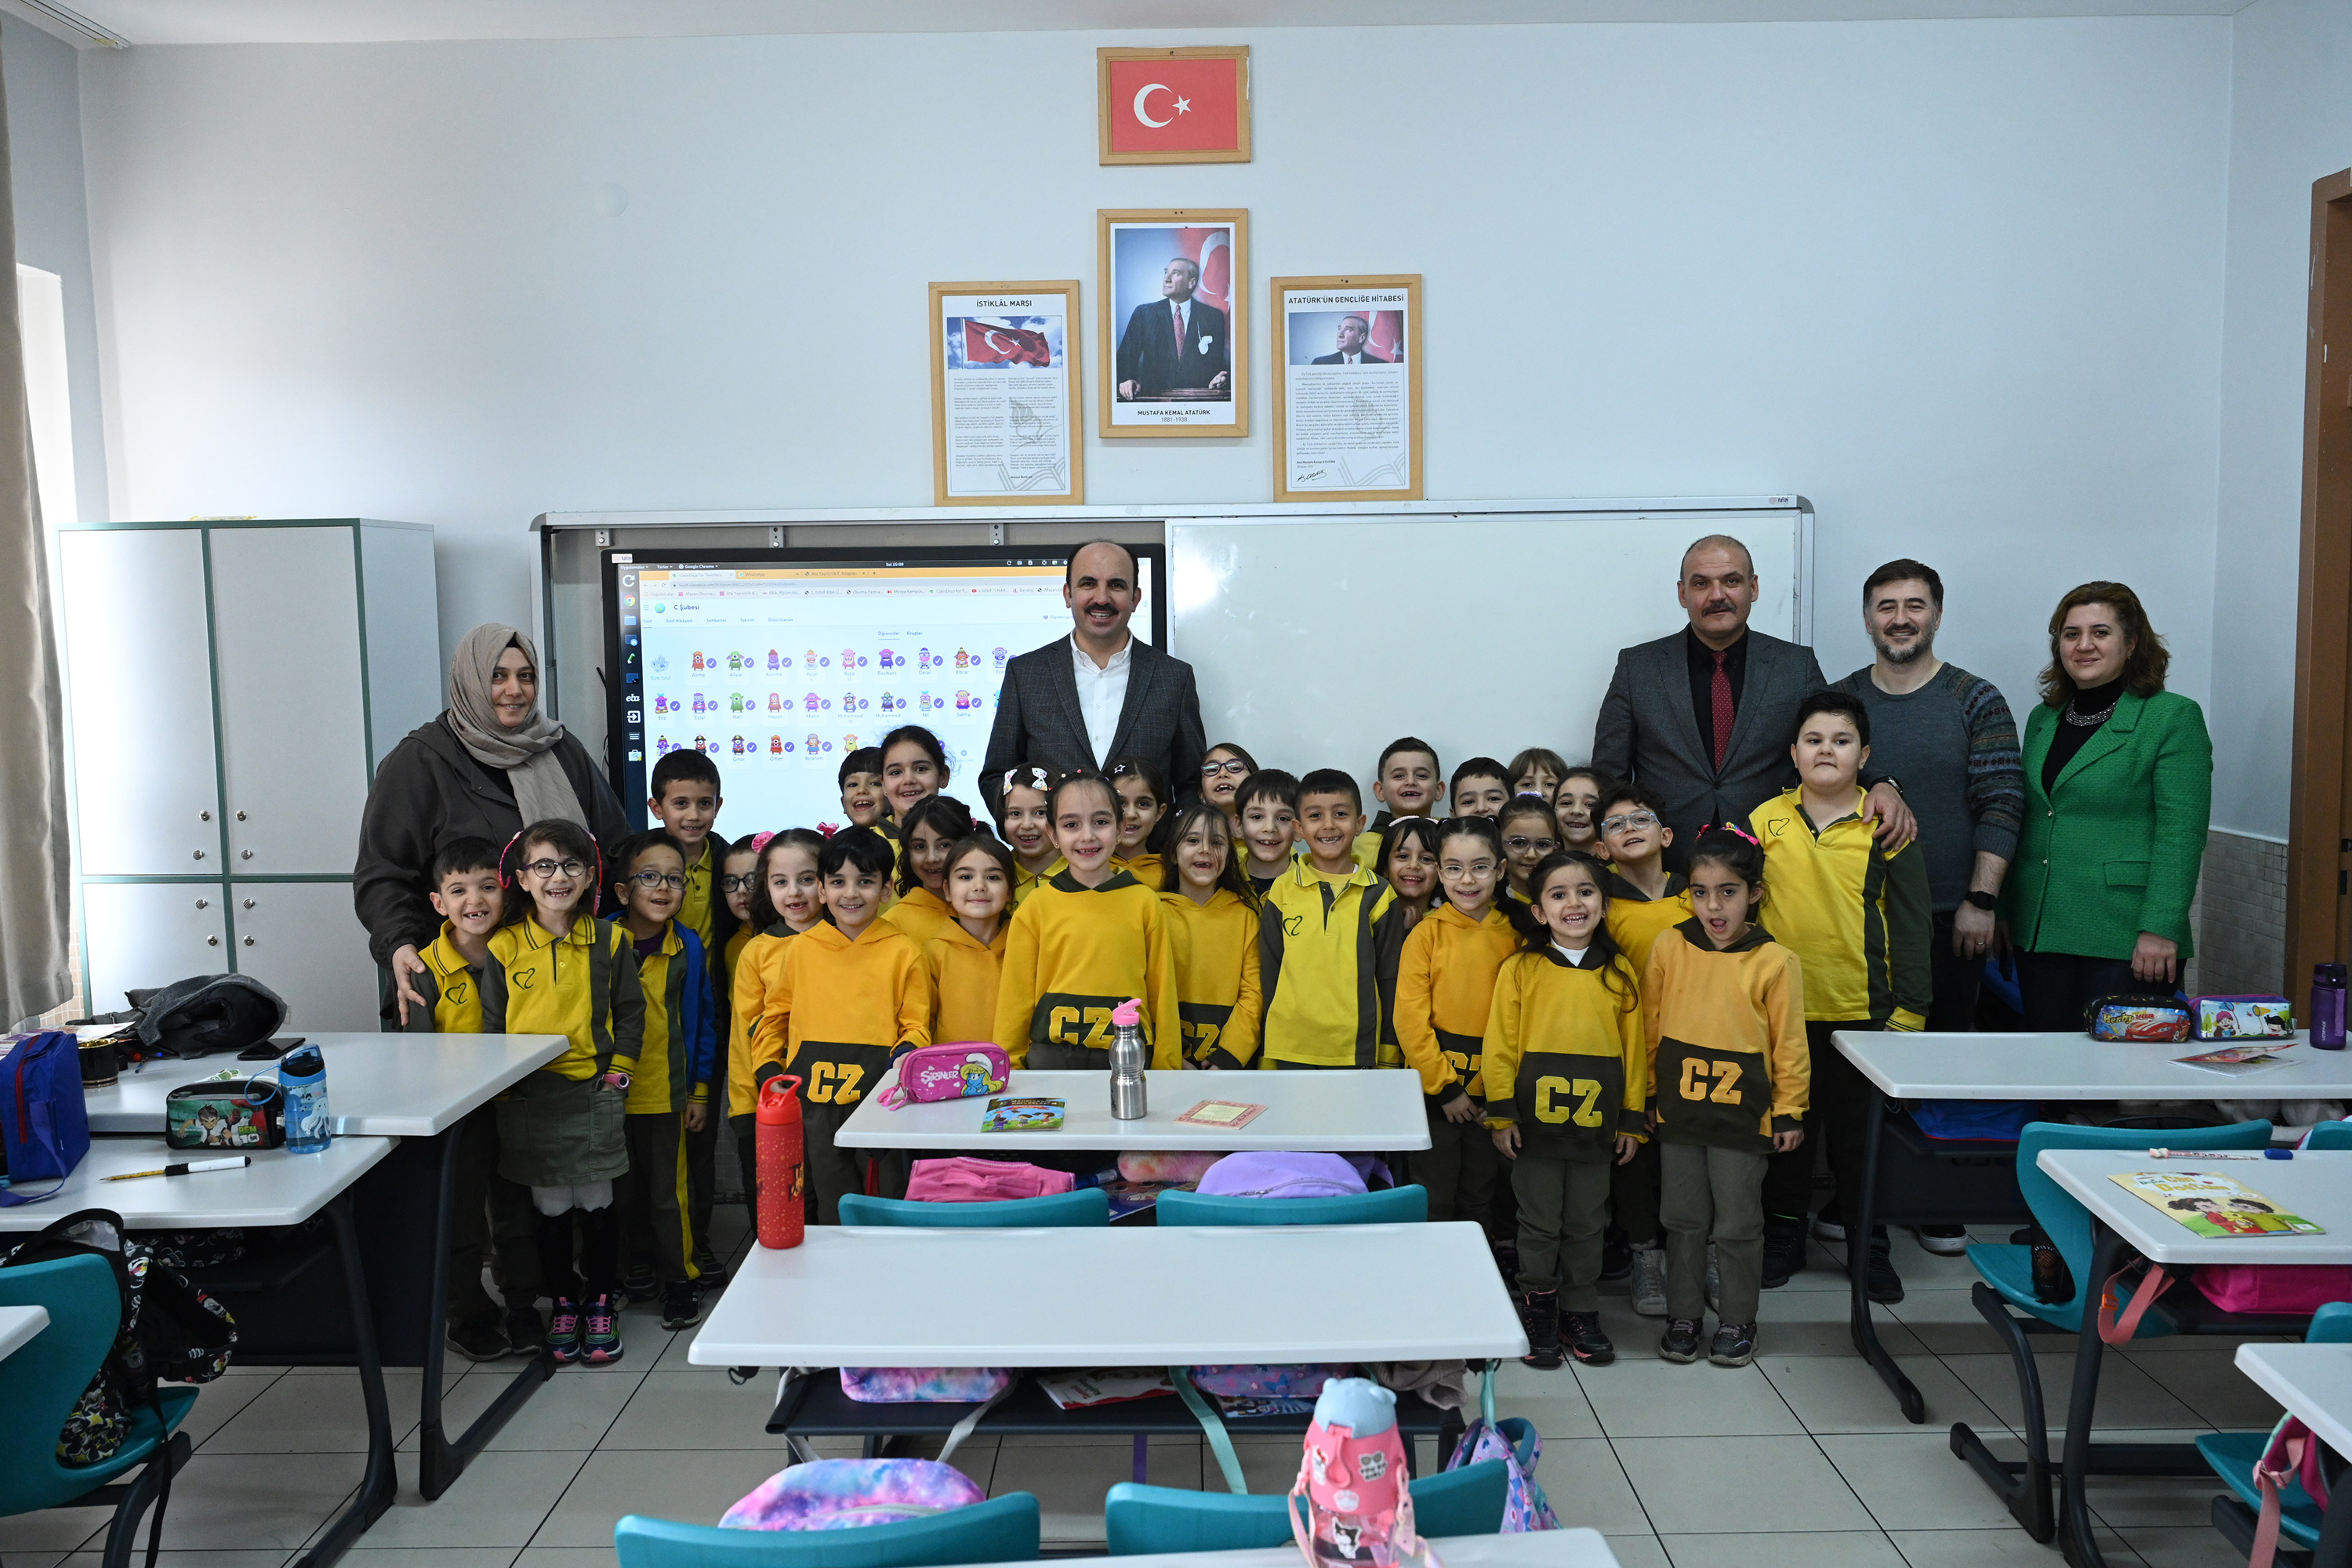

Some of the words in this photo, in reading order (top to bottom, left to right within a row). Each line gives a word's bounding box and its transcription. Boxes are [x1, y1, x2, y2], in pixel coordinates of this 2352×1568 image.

[976, 299, 1008, 307] İSTİKLÂL
[1288, 295, 1334, 304] ATATÜRK'ÜN
[1334, 294, 1370, 303] GENÇLİĞE
[1371, 293, 1404, 303] HİTABESİ
[626, 693, 641, 702] eba
[2102, 1011, 2135, 1025] Herby
[1049, 1005, 1116, 1051] CZ
[807, 1061, 866, 1105] CZ
[1679, 1057, 1744, 1105] CZ
[1534, 1075, 1603, 1127] CZ
[238, 1126, 258, 1135] BEN
[239, 1133, 260, 1145] 10
